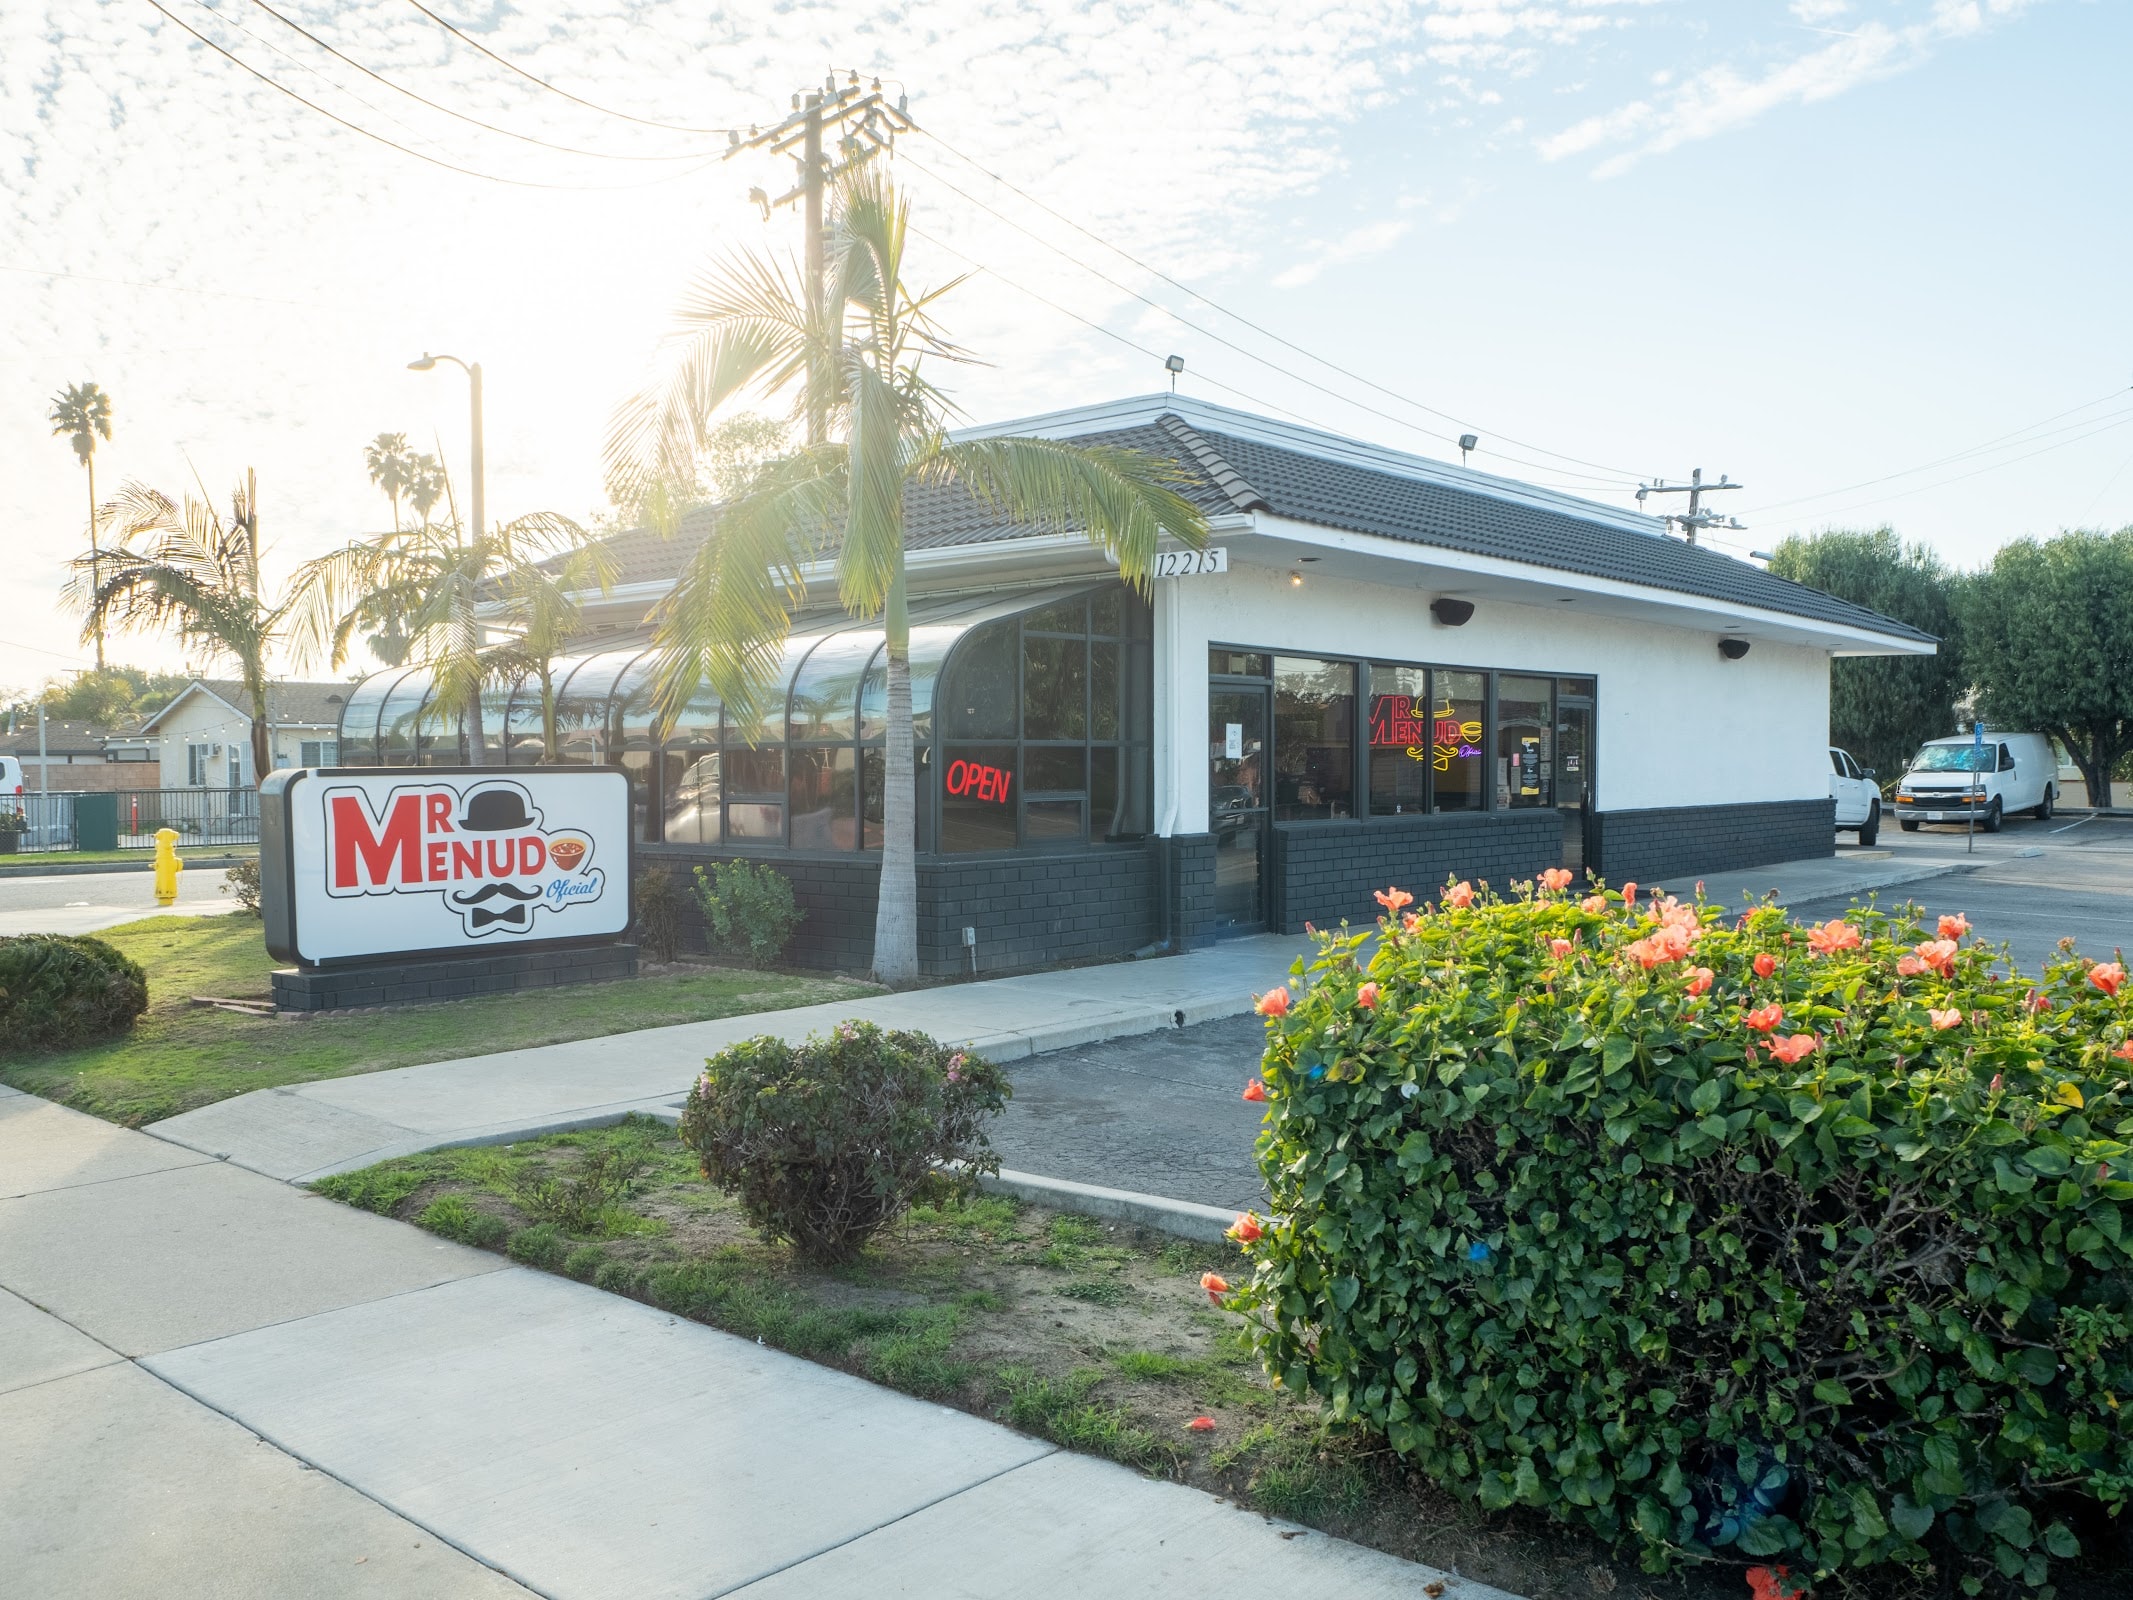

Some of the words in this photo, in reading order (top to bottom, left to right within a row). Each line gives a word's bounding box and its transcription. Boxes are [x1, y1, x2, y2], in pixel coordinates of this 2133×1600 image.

[1157, 551, 1219, 576] 12215
[947, 760, 1011, 803] OPEN
[546, 877, 598, 903] Oficial
